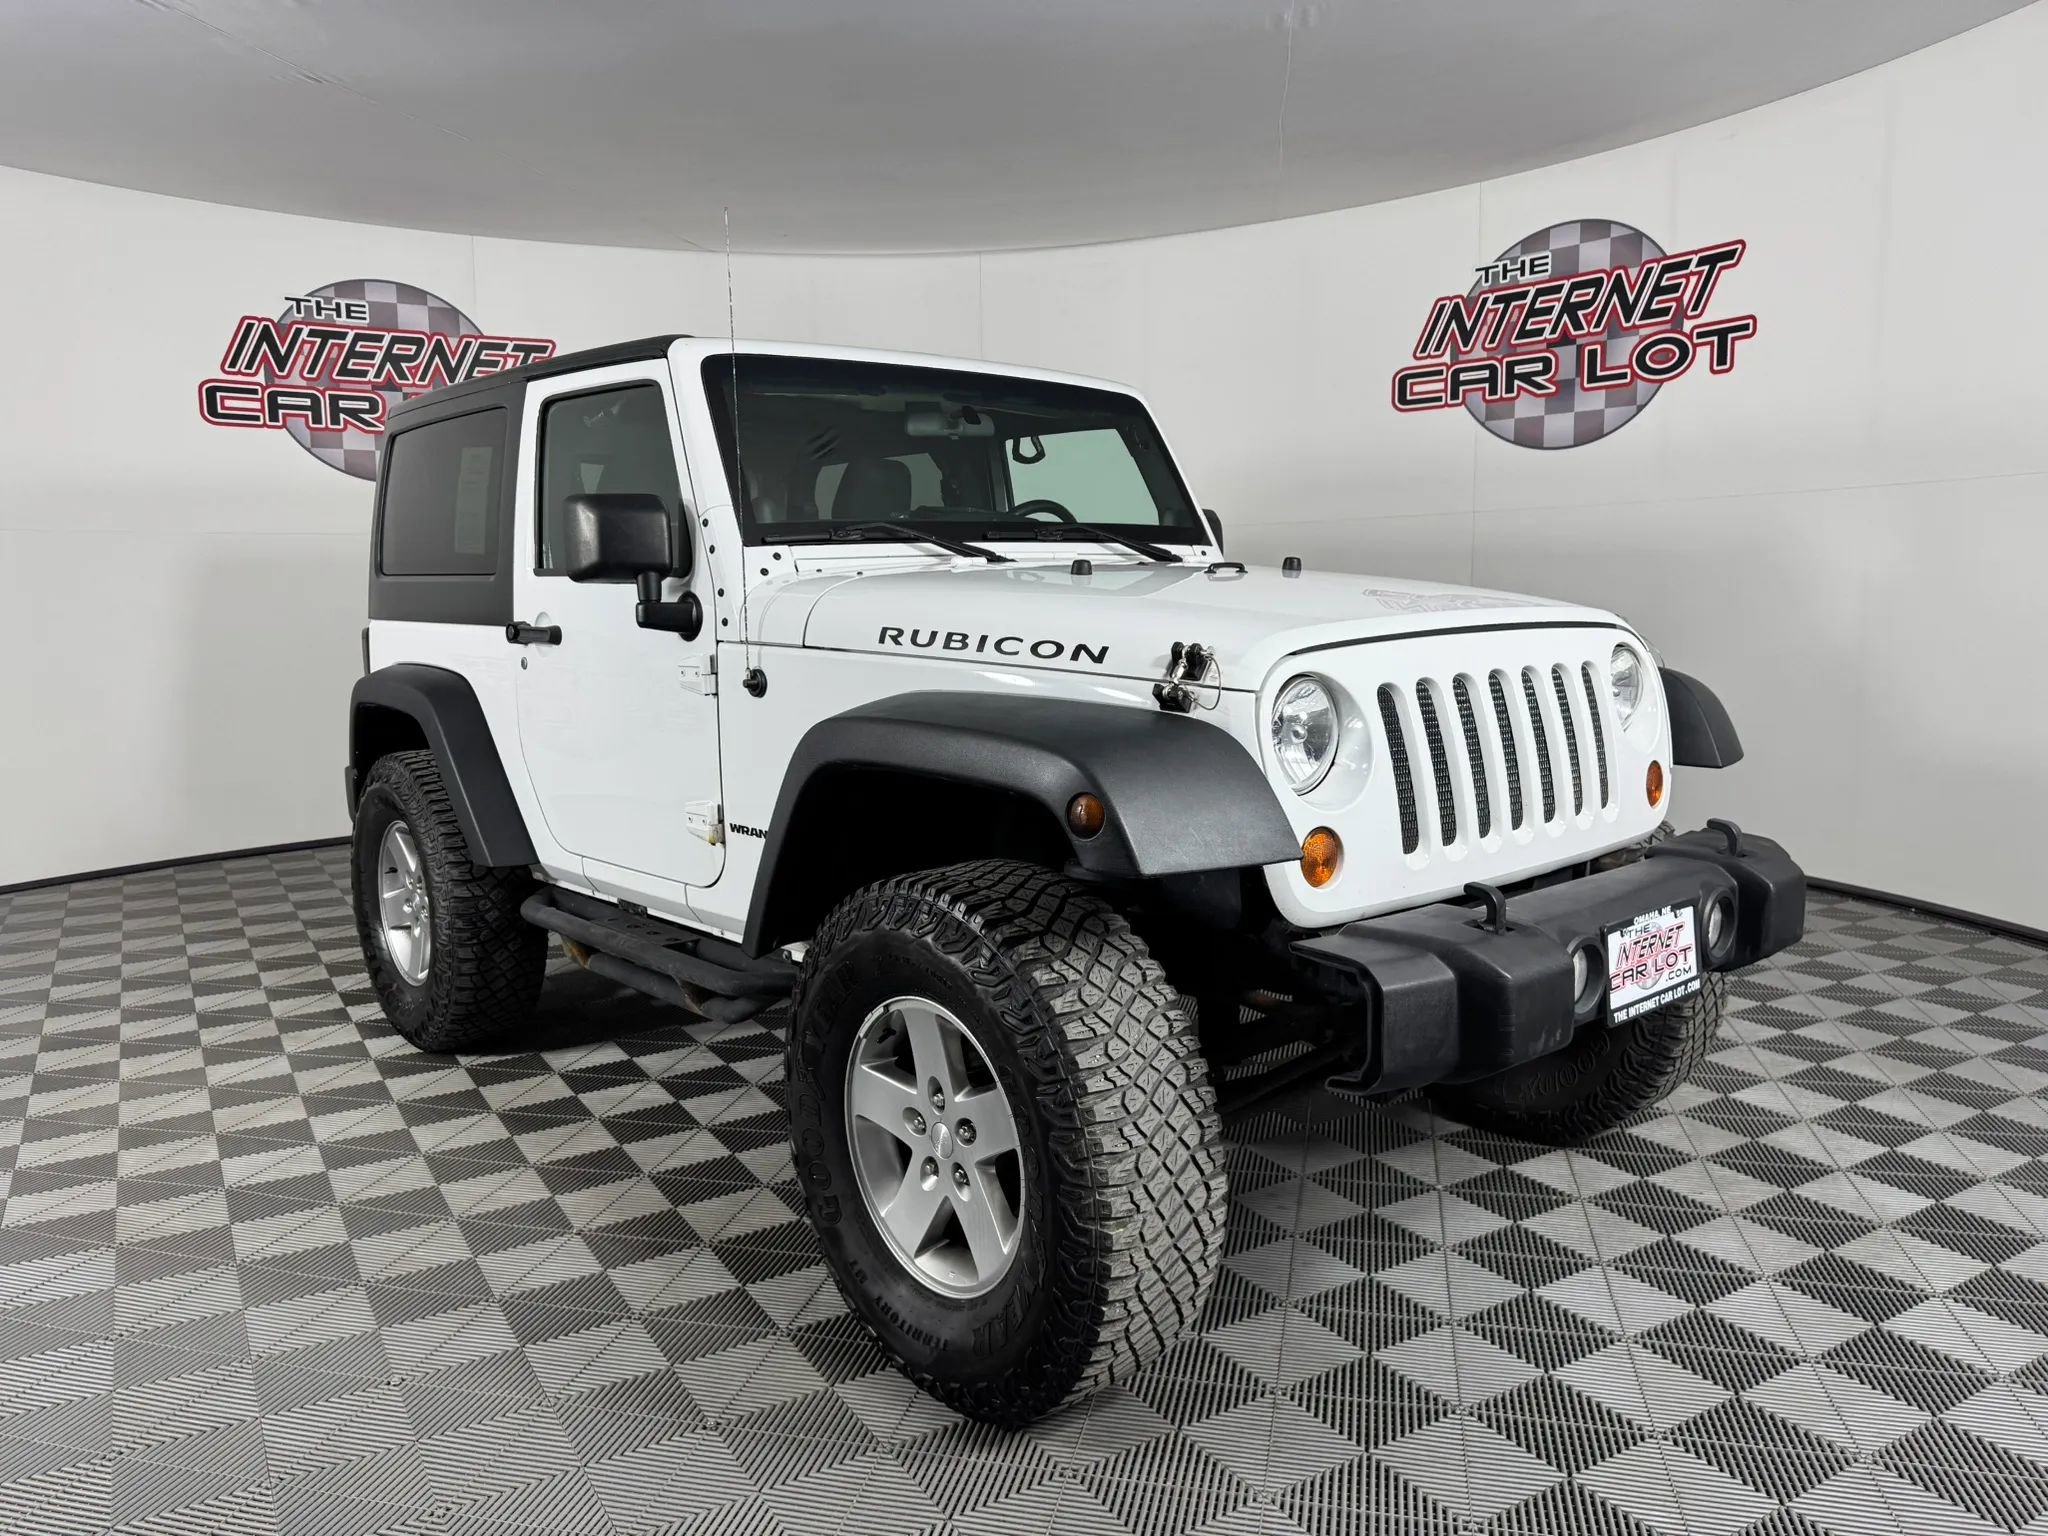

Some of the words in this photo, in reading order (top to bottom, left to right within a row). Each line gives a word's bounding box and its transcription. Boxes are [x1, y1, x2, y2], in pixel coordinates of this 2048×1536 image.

[1474, 252, 1551, 284] THE
[284, 296, 368, 322] THE
[1415, 241, 1743, 358] INTERNET
[1394, 352, 1556, 408] CAR
[1582, 316, 1754, 390] LOT
[202, 384, 386, 430] CAR
[878, 626, 1110, 664] RUBICON
[1628, 924, 1651, 937] THE
[1633, 911, 1659, 925] OMAHA
[1661, 905, 1672, 915] NE
[1616, 923, 1685, 968] INTERNET
[1609, 963, 1648, 991] CAR
[1653, 946, 1692, 973] LOT
[1665, 965, 1692, 982] .COM
[1613, 1010, 1628, 1023] THE
[1628, 997, 1660, 1018] INTERNET
[1660, 990, 1674, 1005] CAR
